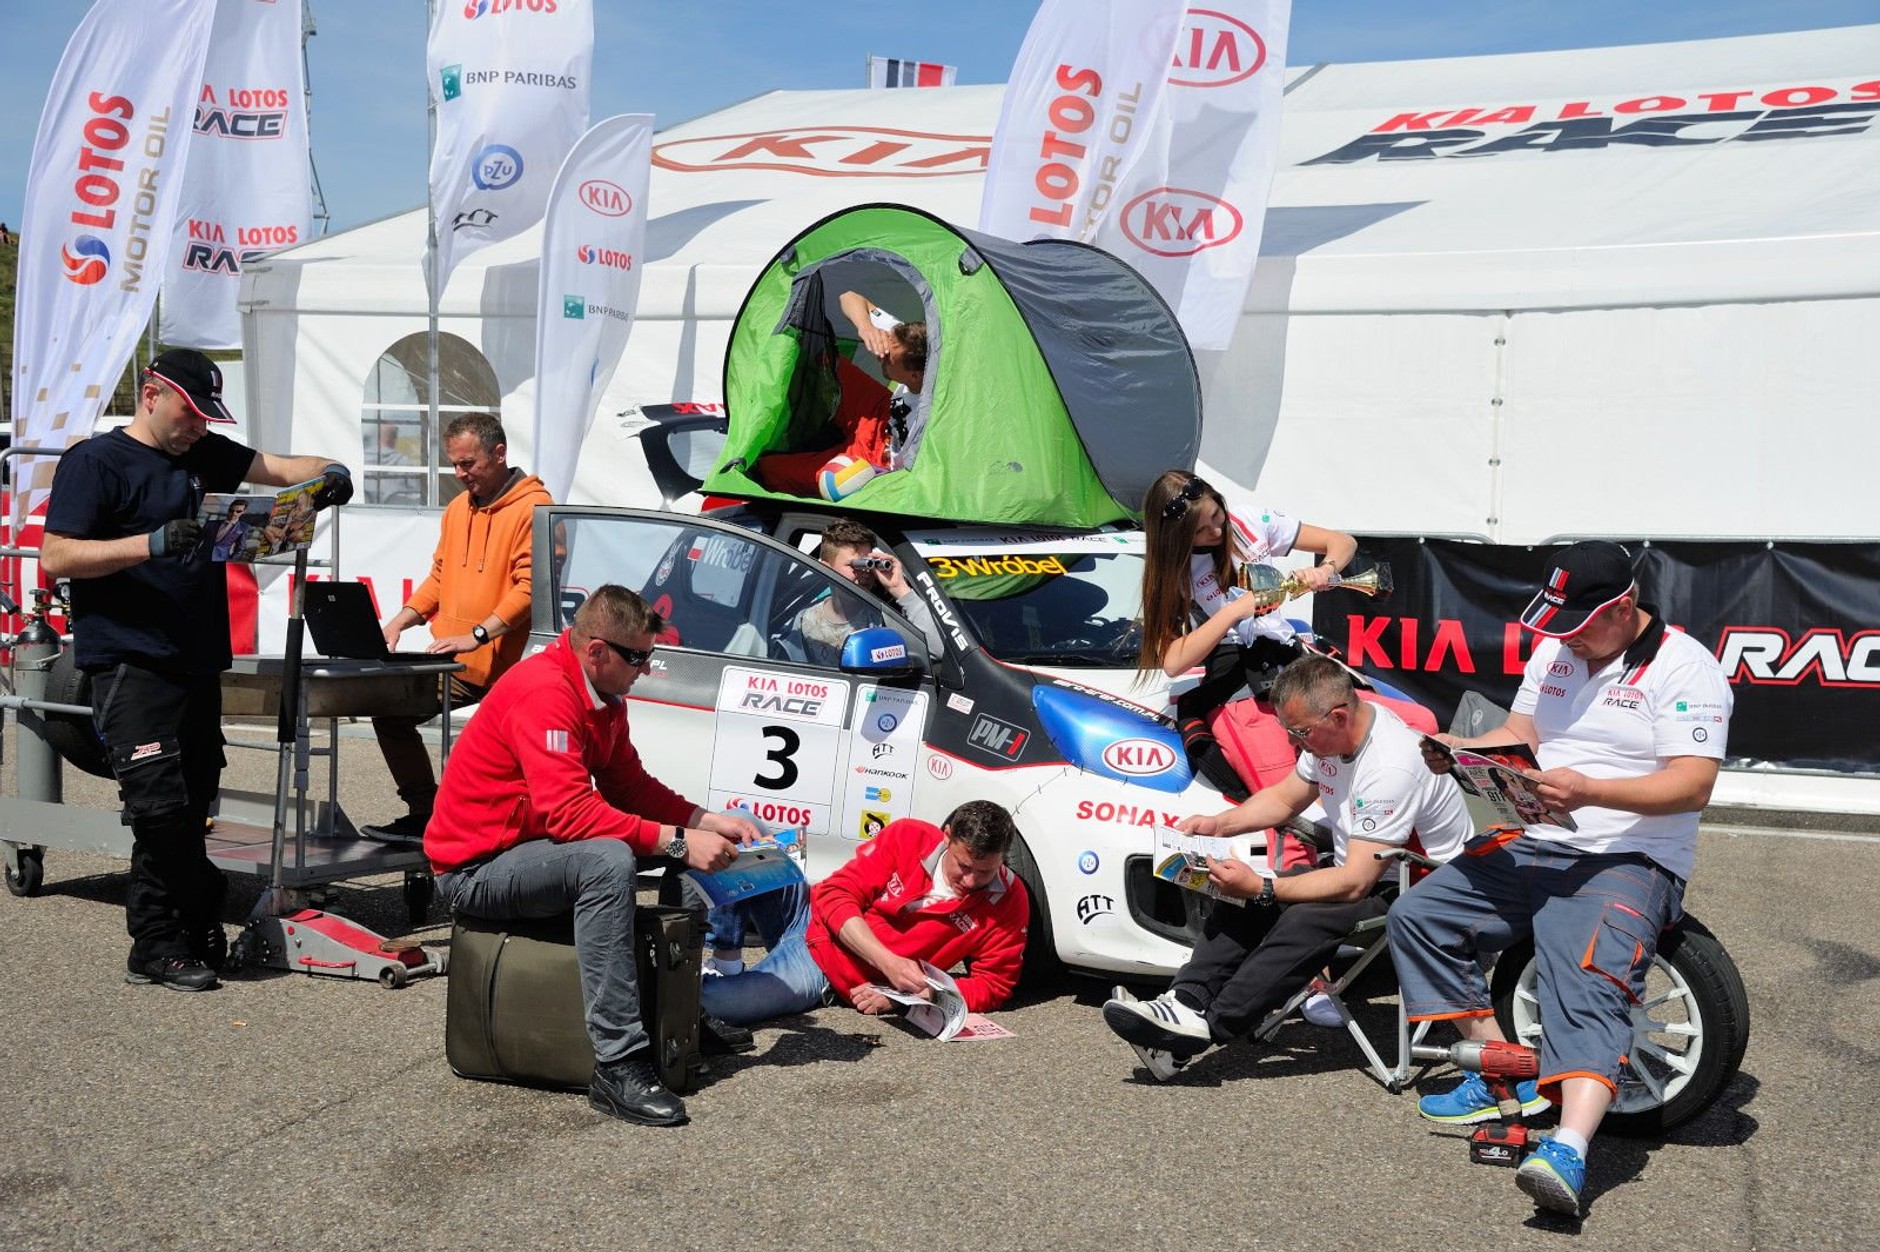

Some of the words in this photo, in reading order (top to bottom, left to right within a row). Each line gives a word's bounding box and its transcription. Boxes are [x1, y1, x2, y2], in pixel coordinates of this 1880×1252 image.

[1172, 28, 1241, 72] IA
[466, 71, 499, 84] BNP
[504, 72, 577, 90] PARIBAS
[228, 88, 288, 108] LOTOS
[1370, 105, 1536, 133] KIA
[1029, 63, 1103, 228] LOTOS
[1293, 101, 1880, 167] RACE
[71, 91, 134, 230] LOTOS
[711, 135, 991, 169] KIA
[1078, 156, 1123, 241] TOR
[1109, 82, 1143, 144] OIL
[119, 167, 161, 293] MOTOR
[144, 105, 171, 159] OIL
[588, 186, 623, 212] KIA
[188, 219, 225, 244] KIA
[238, 225, 298, 246] LOTOS
[1142, 201, 1215, 240] KIA
[186, 244, 267, 273] RA
[598, 250, 632, 272] LOTOS
[589, 304, 609, 315] BNP
[916, 571, 969, 652] PROVIS
[885, 648, 903, 659] LOTOS
[1347, 614, 1477, 674] KIA
[1550, 663, 1569, 676] KIA
[748, 676, 778, 692] KIA
[788, 682, 829, 698] LOTOS
[1545, 685, 1567, 698] LOTOS
[742, 692, 822, 717] RACE
[1602, 698, 1640, 710] RACE
[754, 725, 801, 791] 3
[931, 758, 949, 777] KIA
[1117, 747, 1164, 767] KIA
[753, 802, 811, 827] LOTOS
[1076, 800, 1180, 829] SONAX
